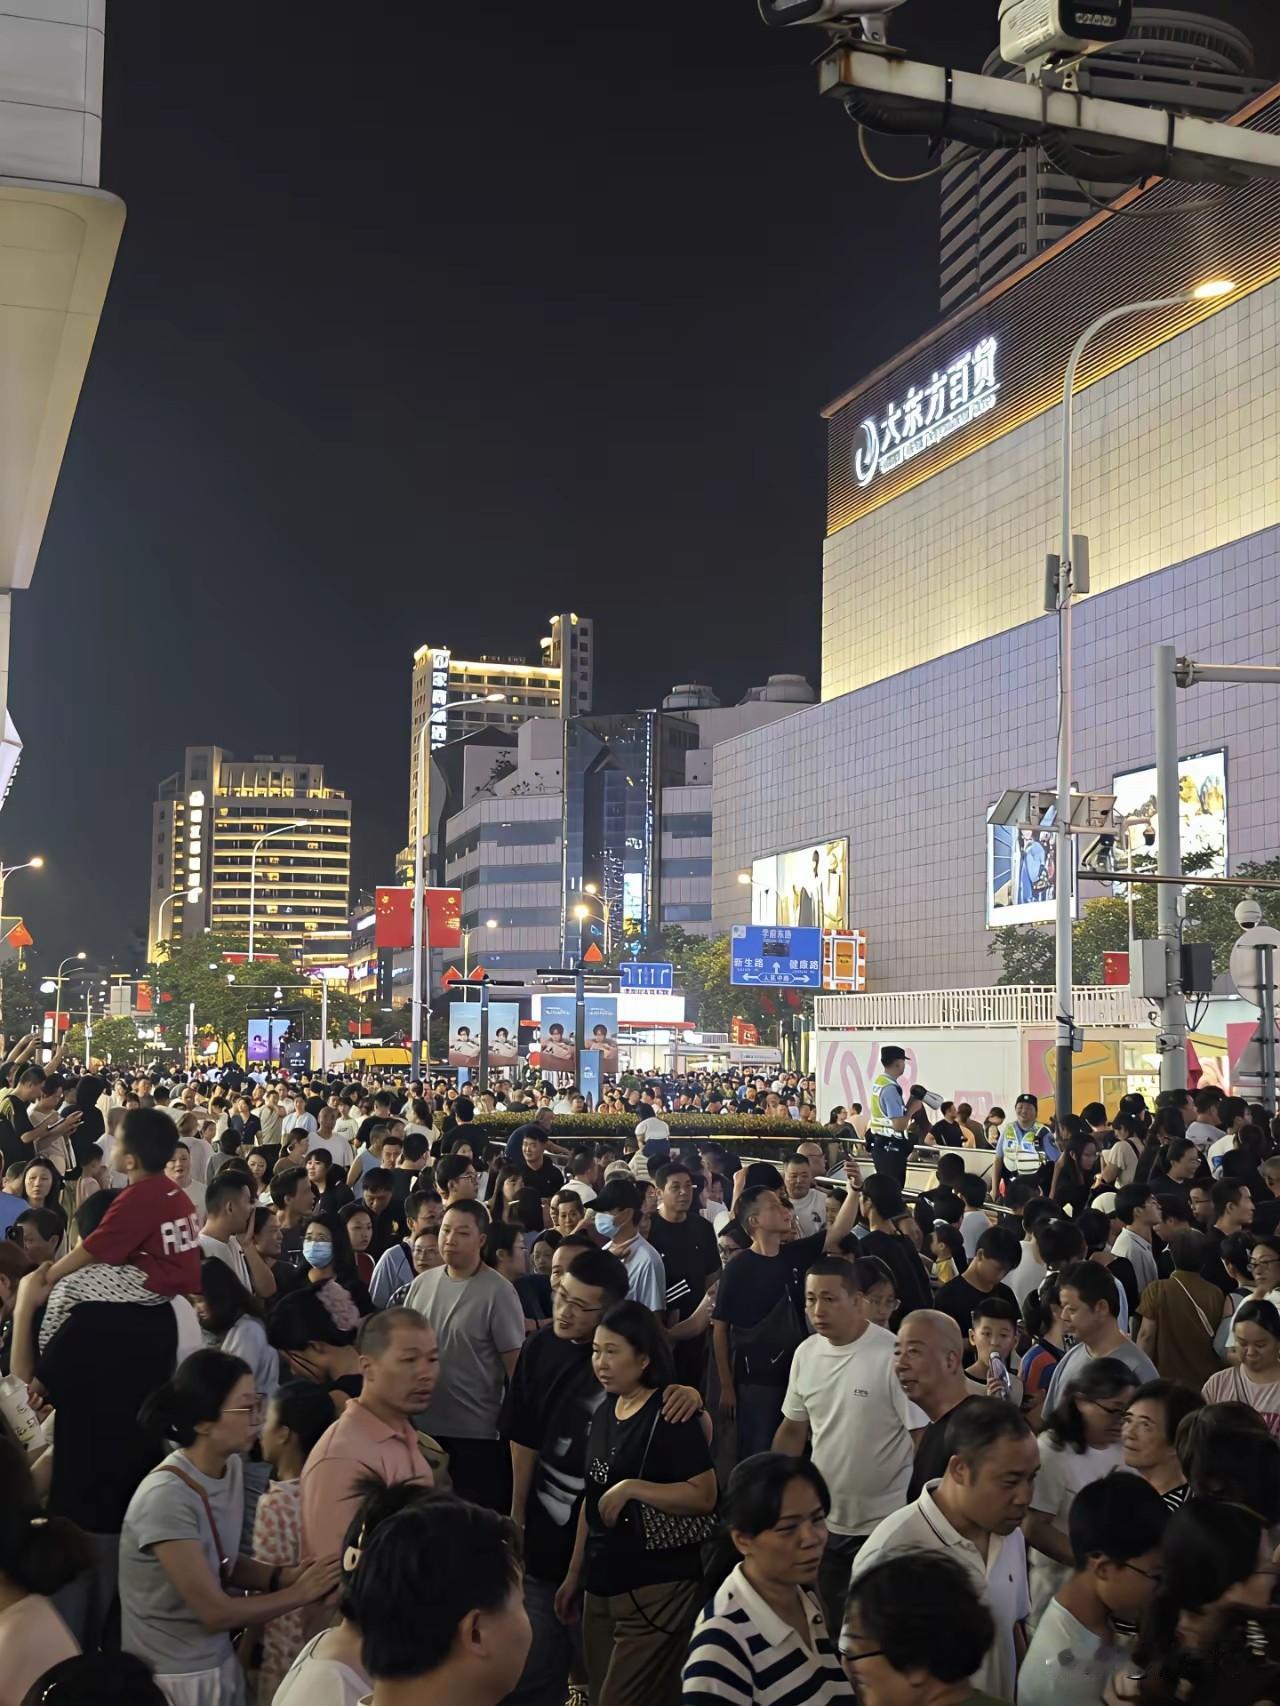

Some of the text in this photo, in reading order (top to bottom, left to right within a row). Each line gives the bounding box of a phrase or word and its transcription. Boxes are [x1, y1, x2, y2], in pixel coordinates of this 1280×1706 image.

[880, 337, 998, 452] 大东方百货
[734, 958, 764, 968] 新生路
[790, 960, 819, 970] 健康路
